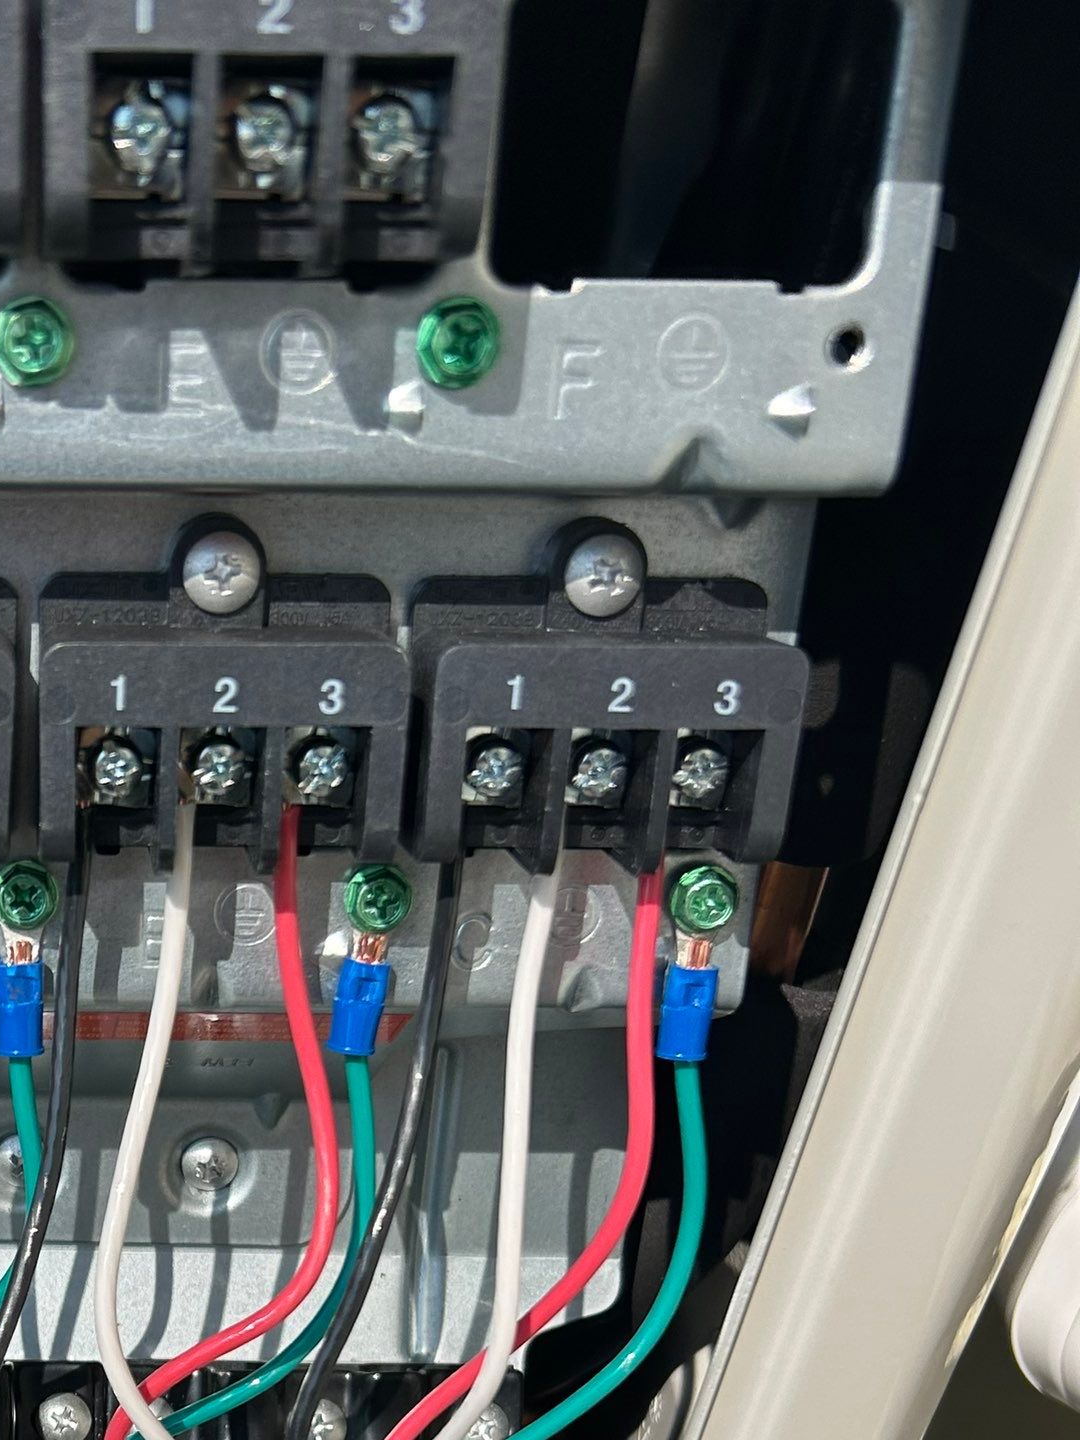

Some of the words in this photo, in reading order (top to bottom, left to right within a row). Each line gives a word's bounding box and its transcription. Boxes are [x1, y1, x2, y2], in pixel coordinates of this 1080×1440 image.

[257, 0, 291, 35] 2
[391, 0, 424, 35] 3
[554, 340, 603, 420] F
[110, 674, 128, 711] 1
[212, 677, 239, 713] 2
[318, 679, 345, 716] 3
[506, 674, 525, 710] 1
[608, 676, 635, 713] 2
[714, 680, 741, 716] 3
